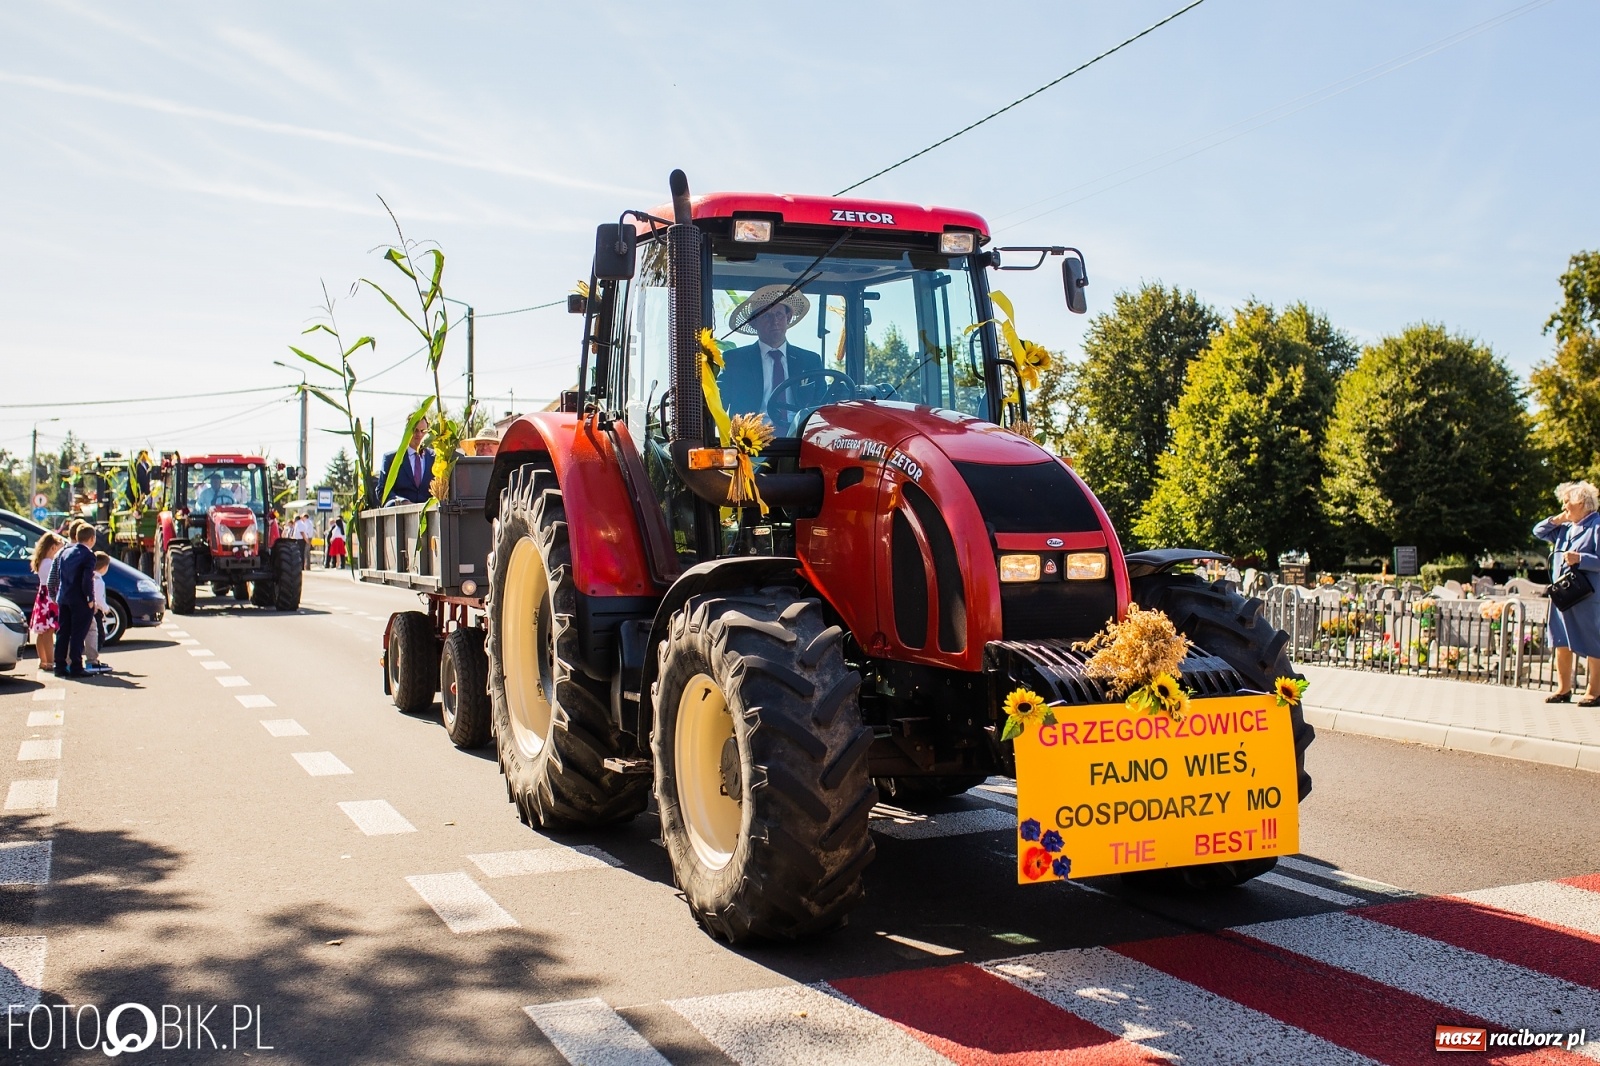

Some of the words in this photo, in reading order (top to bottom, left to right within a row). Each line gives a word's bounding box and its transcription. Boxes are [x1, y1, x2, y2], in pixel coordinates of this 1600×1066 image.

[831, 209, 895, 225] ZETOR
[832, 438, 862, 450] FORTERRA
[862, 440, 888, 459] 11441
[890, 449, 923, 482] ZETOR
[1038, 709, 1268, 747] GRZEGORZOWICE
[1090, 757, 1168, 786] FAJNO
[1184, 742, 1256, 778] WIEŚ,
[1055, 791, 1231, 829] GOSPODARZY
[1247, 786, 1282, 811] MO
[1109, 839, 1156, 865] THE
[1194, 818, 1277, 857] BEST!!!
